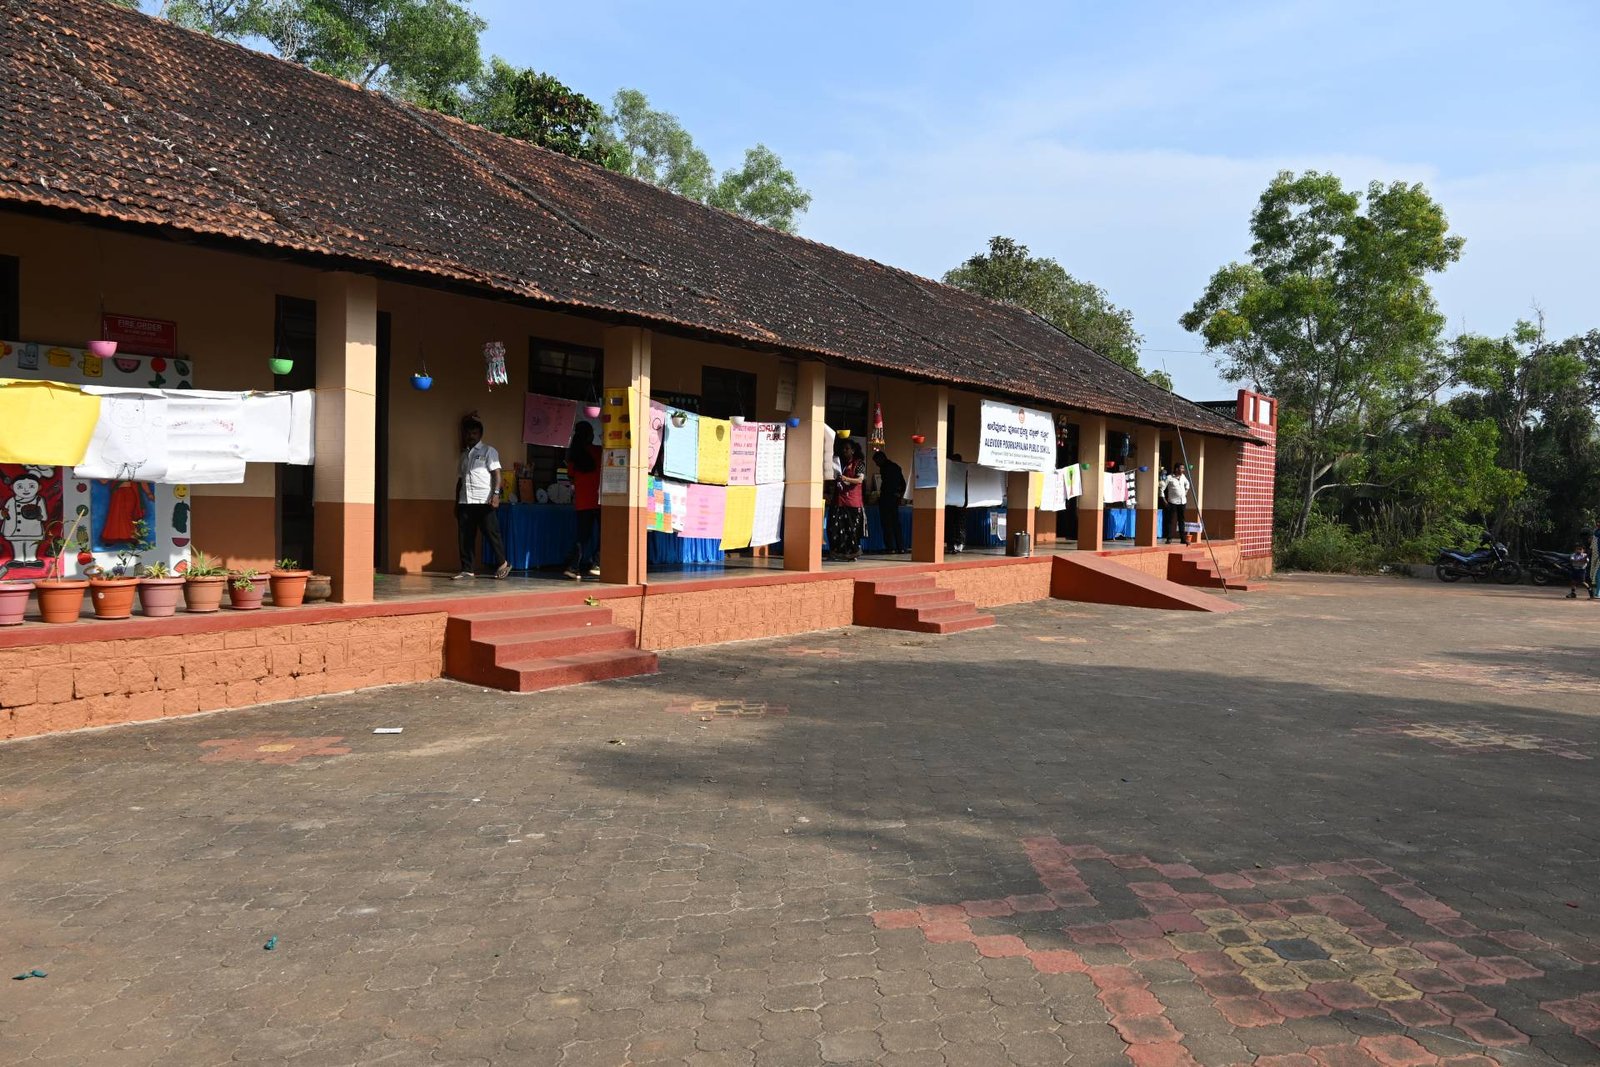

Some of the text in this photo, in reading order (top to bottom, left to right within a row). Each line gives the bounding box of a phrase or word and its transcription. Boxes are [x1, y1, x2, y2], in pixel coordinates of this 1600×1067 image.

[118, 319, 162, 331] FIRE ORDER
[985, 438, 1002, 448] ALEVOOR
[1029, 443, 1039, 453] PUBLIC
